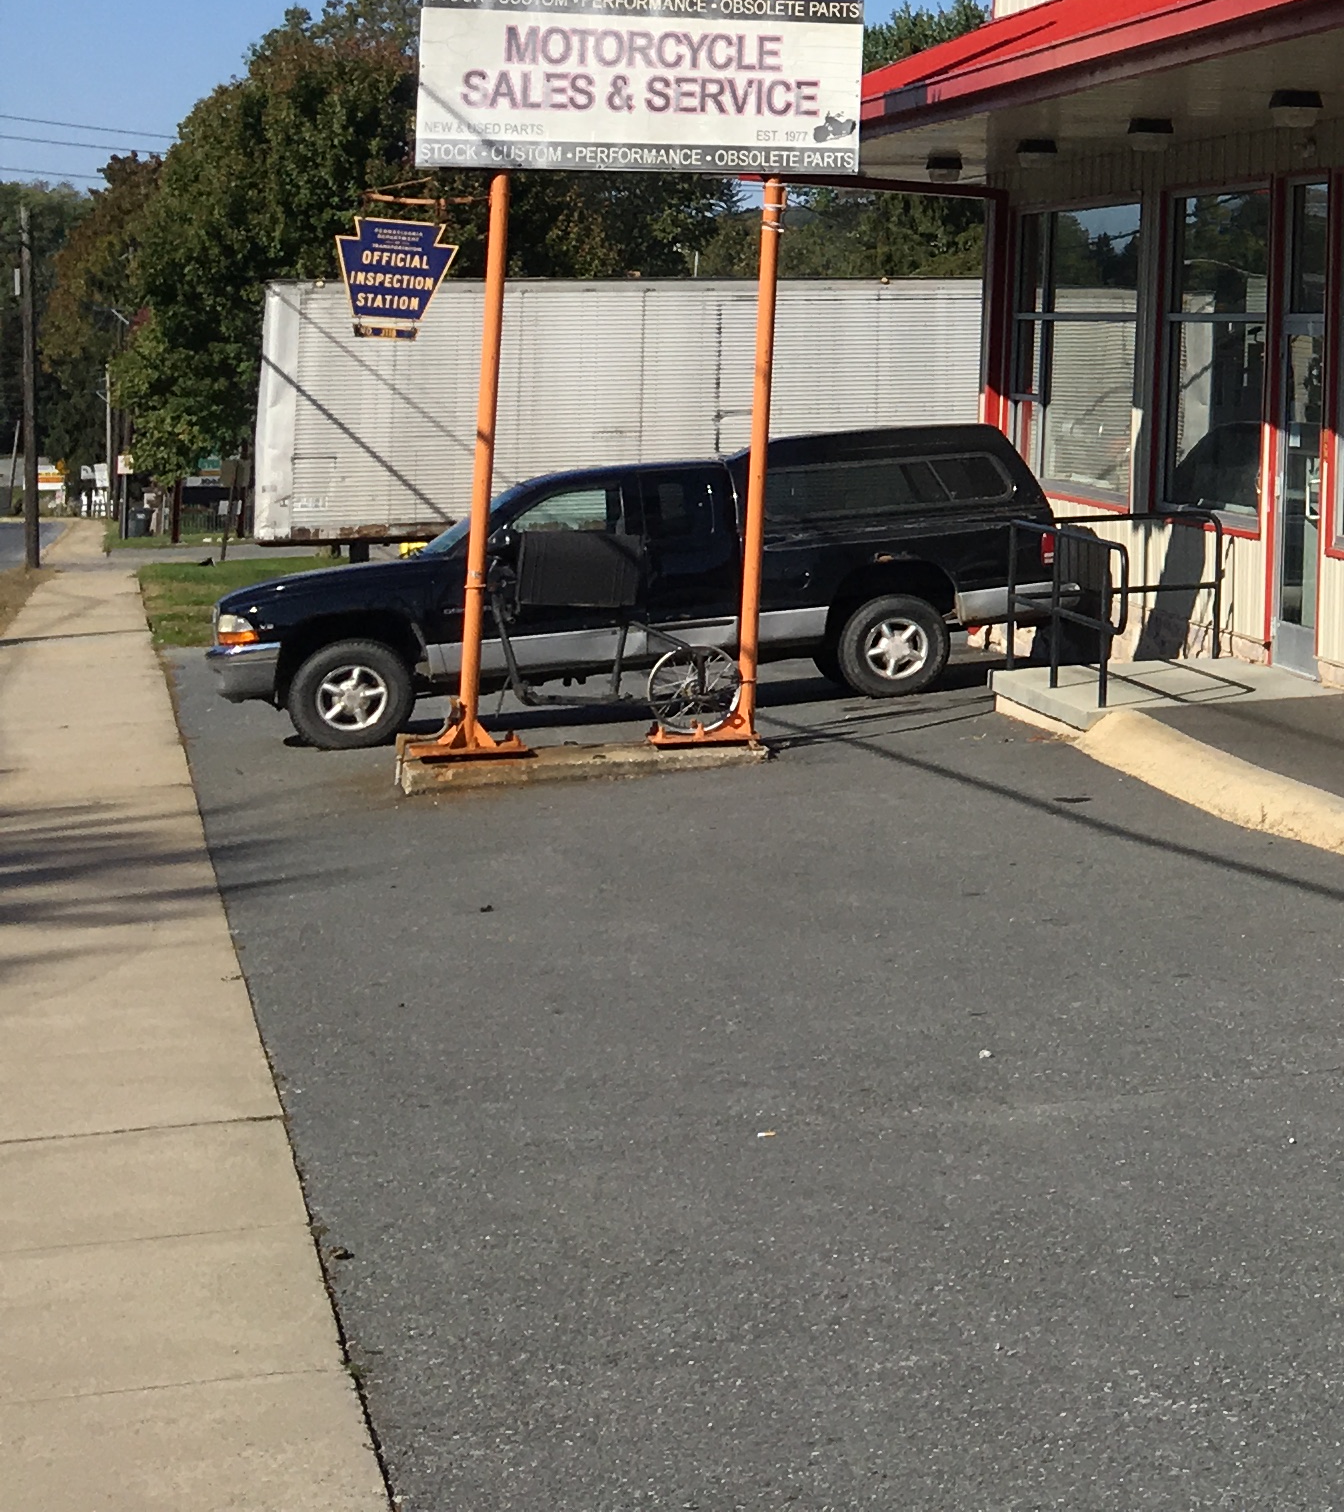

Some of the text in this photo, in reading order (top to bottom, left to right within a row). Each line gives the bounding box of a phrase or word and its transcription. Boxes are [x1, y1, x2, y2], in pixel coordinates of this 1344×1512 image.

[808, 1, 860, 19] PARTS
[504, 24, 784, 73] MOTORCYCLE
[460, 69, 820, 118] SALES & SERVICE
[424, 121, 454, 134] NEW
[467, 122, 501, 135] USED
[503, 123, 544, 136] PARTS
[784, 130, 808, 143] 1977
[420, 143, 855, 169] STOCK CUSTOM PERFORMANCE OBSOLETE PARTS
[361, 250, 430, 269] OFFICIAL
[350, 271, 434, 290] INSPECTION
[356, 292, 420, 311] STATION
